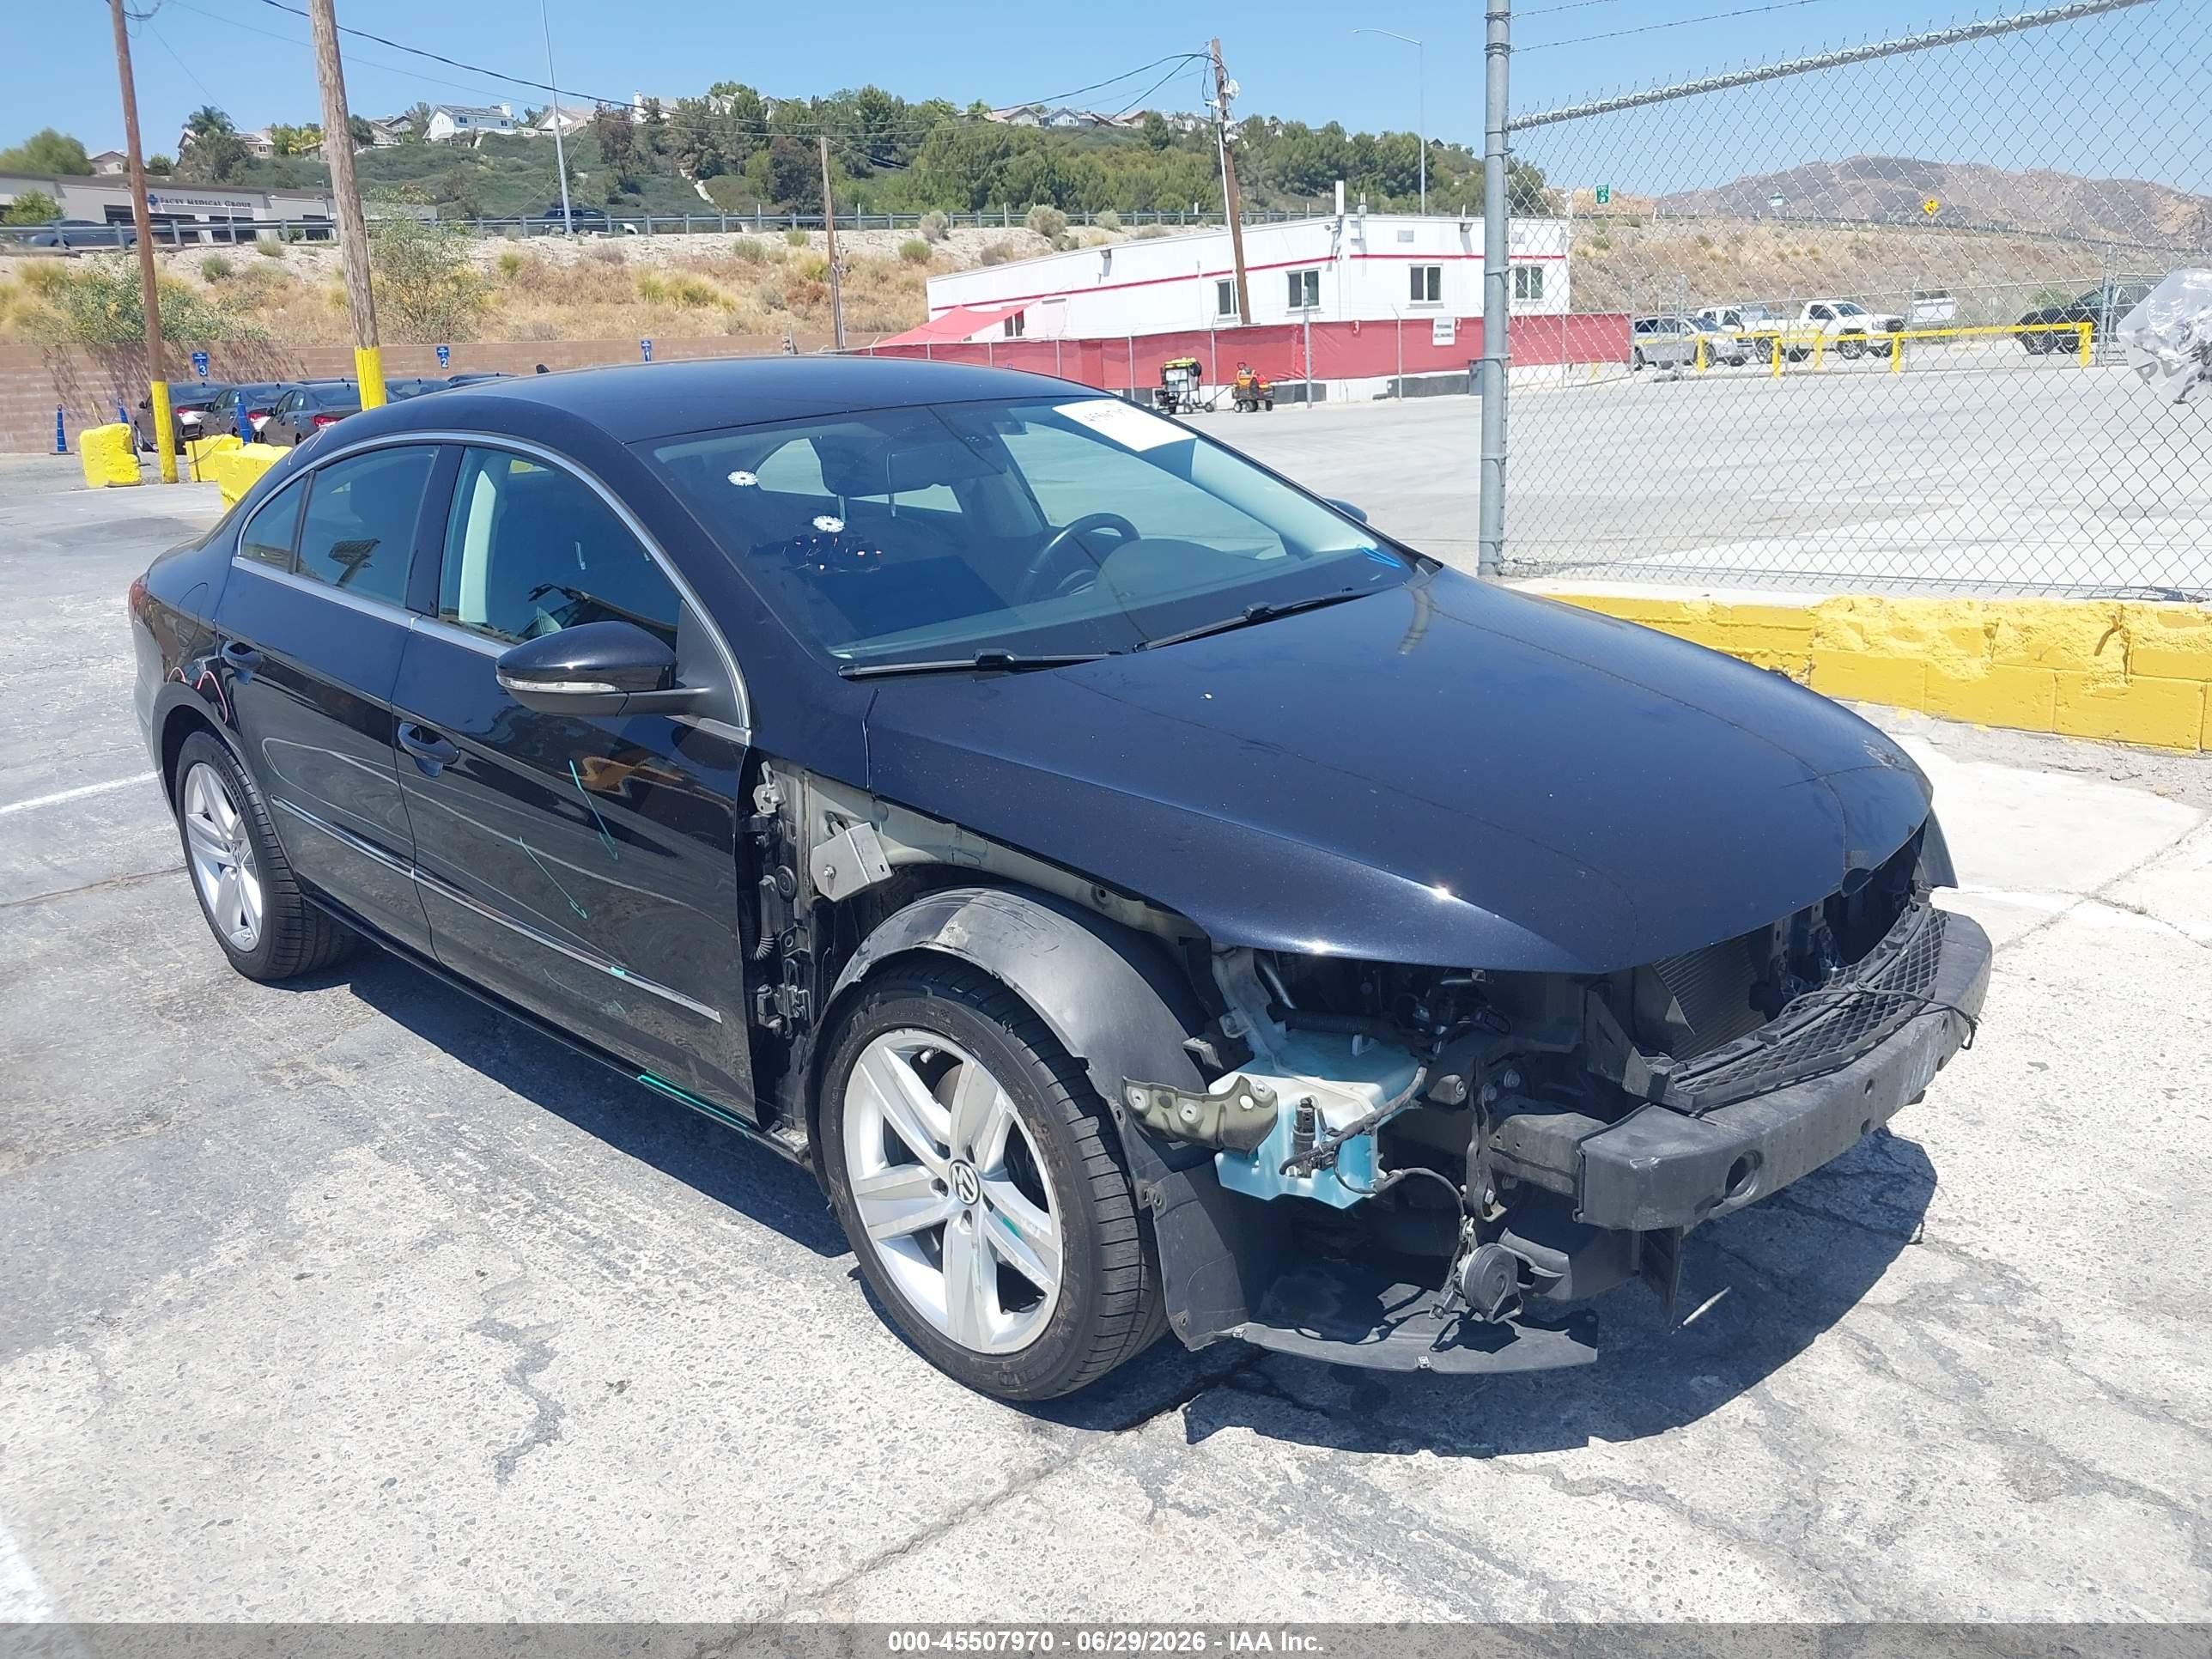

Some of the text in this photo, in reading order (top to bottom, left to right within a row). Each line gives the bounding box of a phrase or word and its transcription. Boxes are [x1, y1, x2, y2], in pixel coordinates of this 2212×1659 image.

[186, 198, 222, 207] MEDICAL
[441, 357, 448, 368] 2
[199, 365, 207, 376] 3
